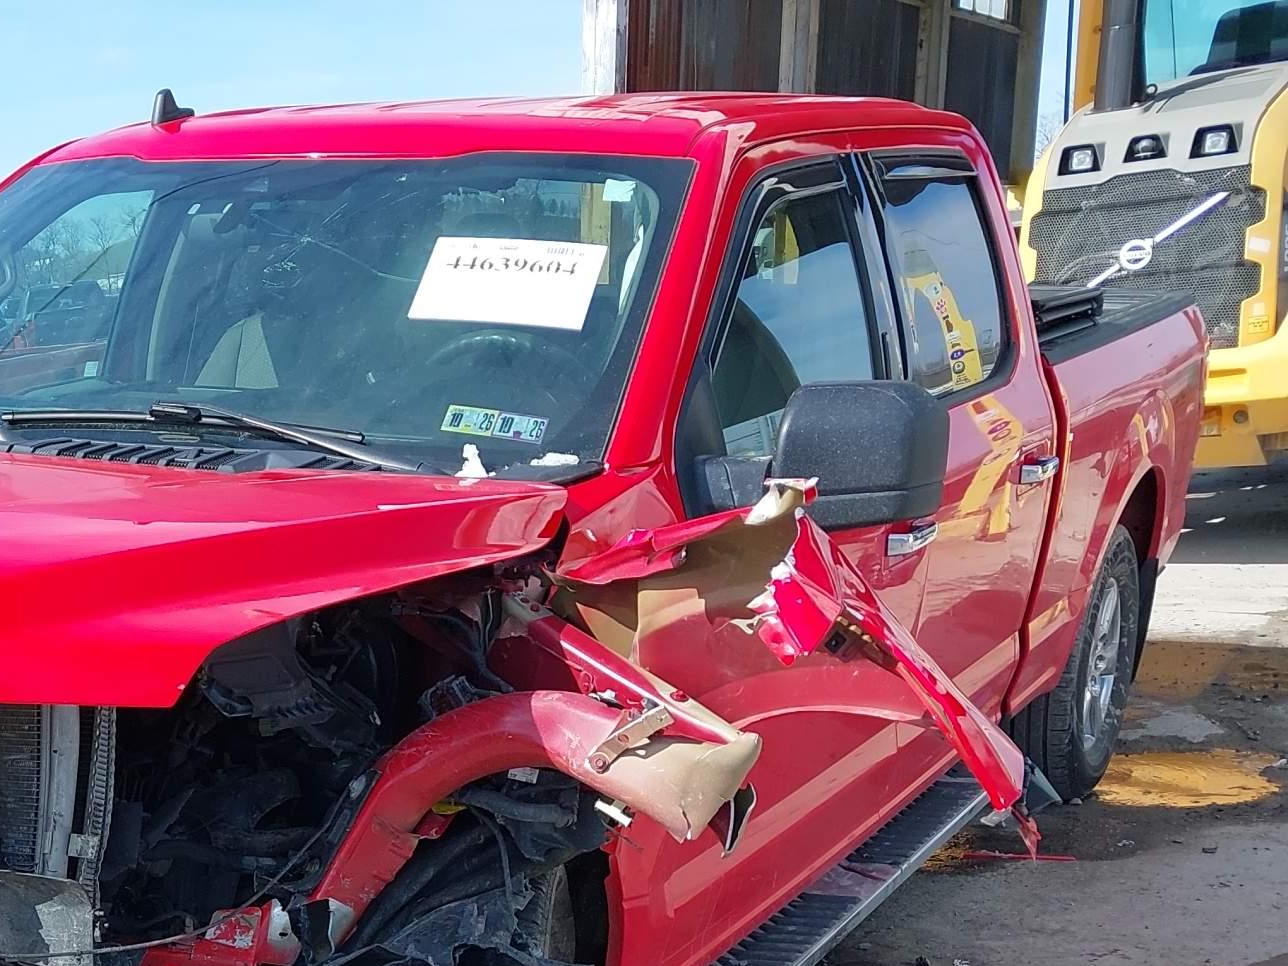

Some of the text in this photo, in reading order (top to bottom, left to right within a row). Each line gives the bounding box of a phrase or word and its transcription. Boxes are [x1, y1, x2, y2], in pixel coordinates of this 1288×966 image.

[449, 412, 495, 432] 10 26
[498, 416, 545, 439] 10 26
